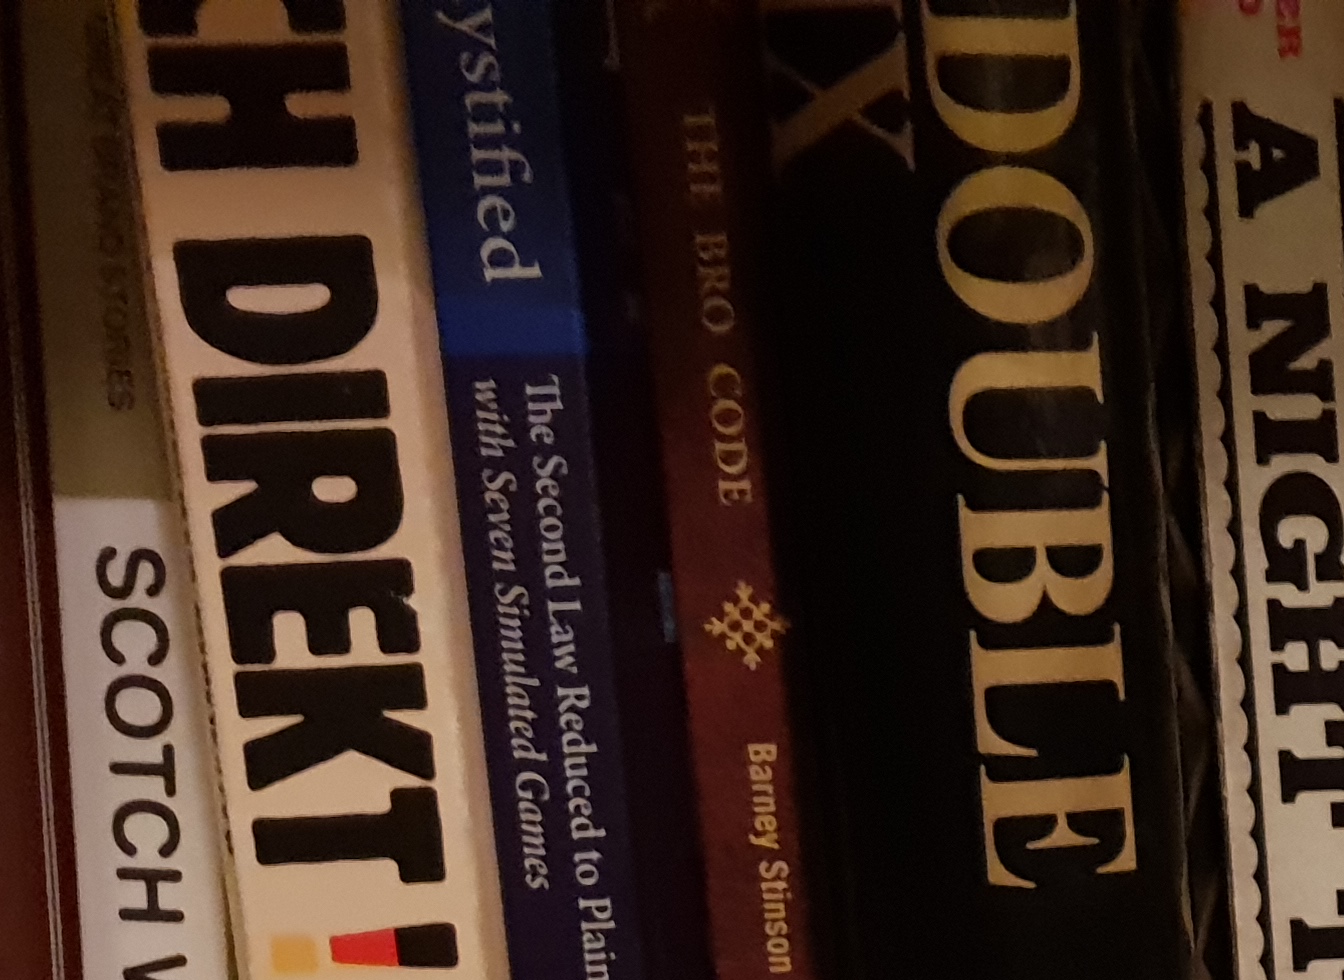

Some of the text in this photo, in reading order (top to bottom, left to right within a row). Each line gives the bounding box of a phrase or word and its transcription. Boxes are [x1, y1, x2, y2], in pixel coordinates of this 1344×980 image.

[435, 3, 541, 282] ystified
[1233, 101, 1320, 218] A
[679, 111, 753, 507] THE BRO CODE
[531, 375, 564, 444] The
[920, 2, 1139, 889] DOUBLE
[535, 456, 586, 590] Second
[471, 379, 553, 890] with Seven Simulated Games
[544, 600, 587, 674] Law
[96, 547, 183, 923] SCOTCH
[556, 685, 604, 838] Reduced
[743, 743, 784, 851] Barney
[568, 850, 605, 884] to
[755, 861, 797, 974] Stinson
